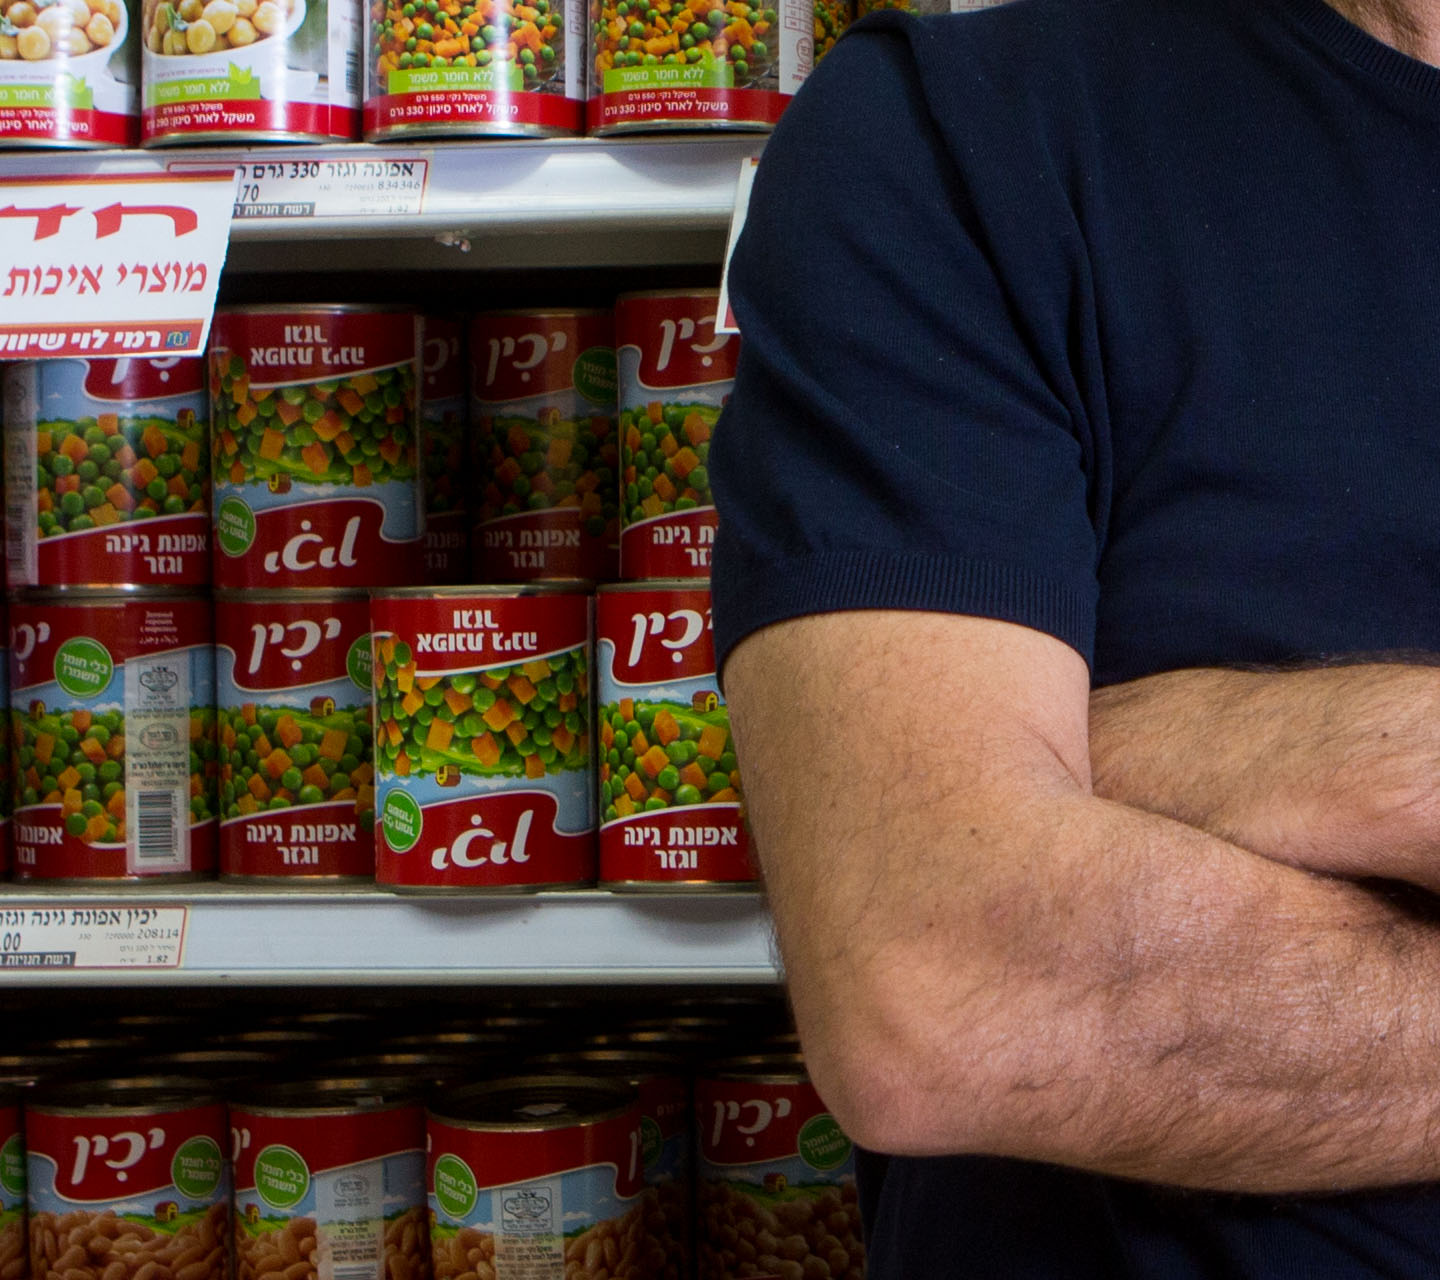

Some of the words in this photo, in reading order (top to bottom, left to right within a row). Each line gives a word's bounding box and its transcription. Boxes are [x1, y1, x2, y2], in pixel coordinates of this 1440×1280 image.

[5, 265, 103, 297] איכות
[117, 262, 208, 297] מוצרי
[73, 328, 108, 351] לוי
[114, 329, 160, 351] רמי
[453, 609, 499, 629] וגזר
[417, 632, 484, 653] אפונת
[492, 631, 538, 652] גינה
[30, 910, 66, 927] גינה
[71, 910, 121, 927] אפונת
[126, 910, 158, 928] יכין
